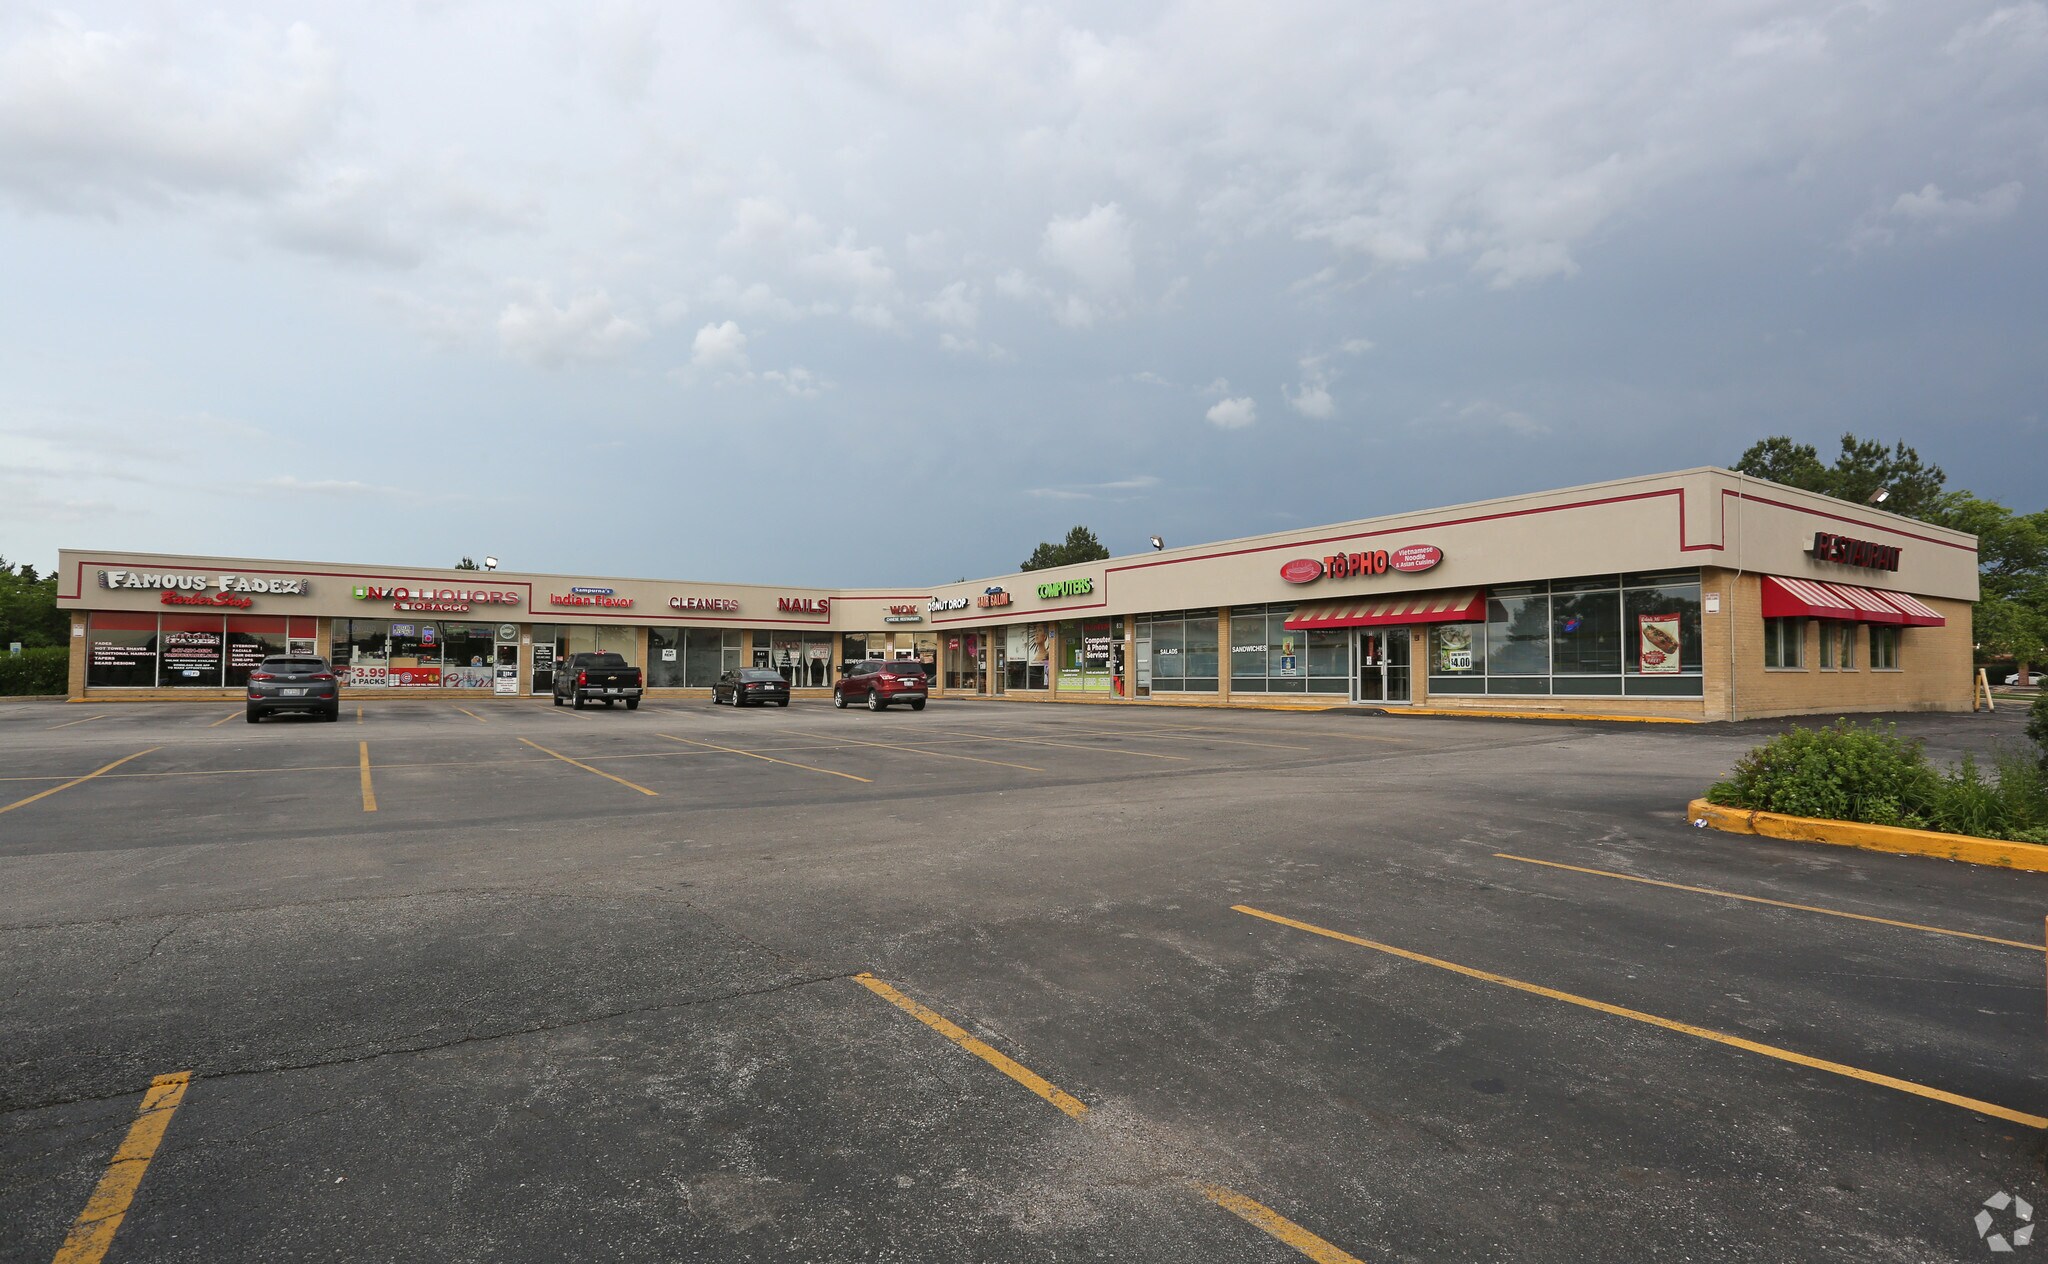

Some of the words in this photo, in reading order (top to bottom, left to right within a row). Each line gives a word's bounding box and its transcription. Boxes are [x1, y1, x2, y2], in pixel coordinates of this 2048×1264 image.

[1399, 547, 1433, 556] Vietnamese
[1814, 532, 1902, 571] RESTAURANT
[1405, 554, 1426, 562] Noodle
[107, 570, 206, 590] FAMOUS
[218, 575, 301, 594] FADEZ
[1037, 578, 1091, 598] COMPUTERS
[418, 589, 519, 605] LIQUORS
[550, 593, 591, 606] Indian
[595, 594, 634, 608] Flavor
[977, 596, 989, 608] HAIR
[990, 593, 1008, 607] SALON
[393, 603, 401, 611] &
[407, 602, 470, 611] TOBACCO
[669, 597, 739, 611] CLEANERS
[778, 597, 828, 614] NAILS
[890, 604, 918, 615] WOK
[928, 600, 948, 611] DONUT
[948, 598, 966, 610] DROP
[1084, 636, 1110, 645] Computer
[1086, 651, 1109, 659] Services
[1232, 645, 1267, 653] SANDWICHES
[1451, 657, 1470, 667] $4.00
[351, 667, 386, 678] $3.99
